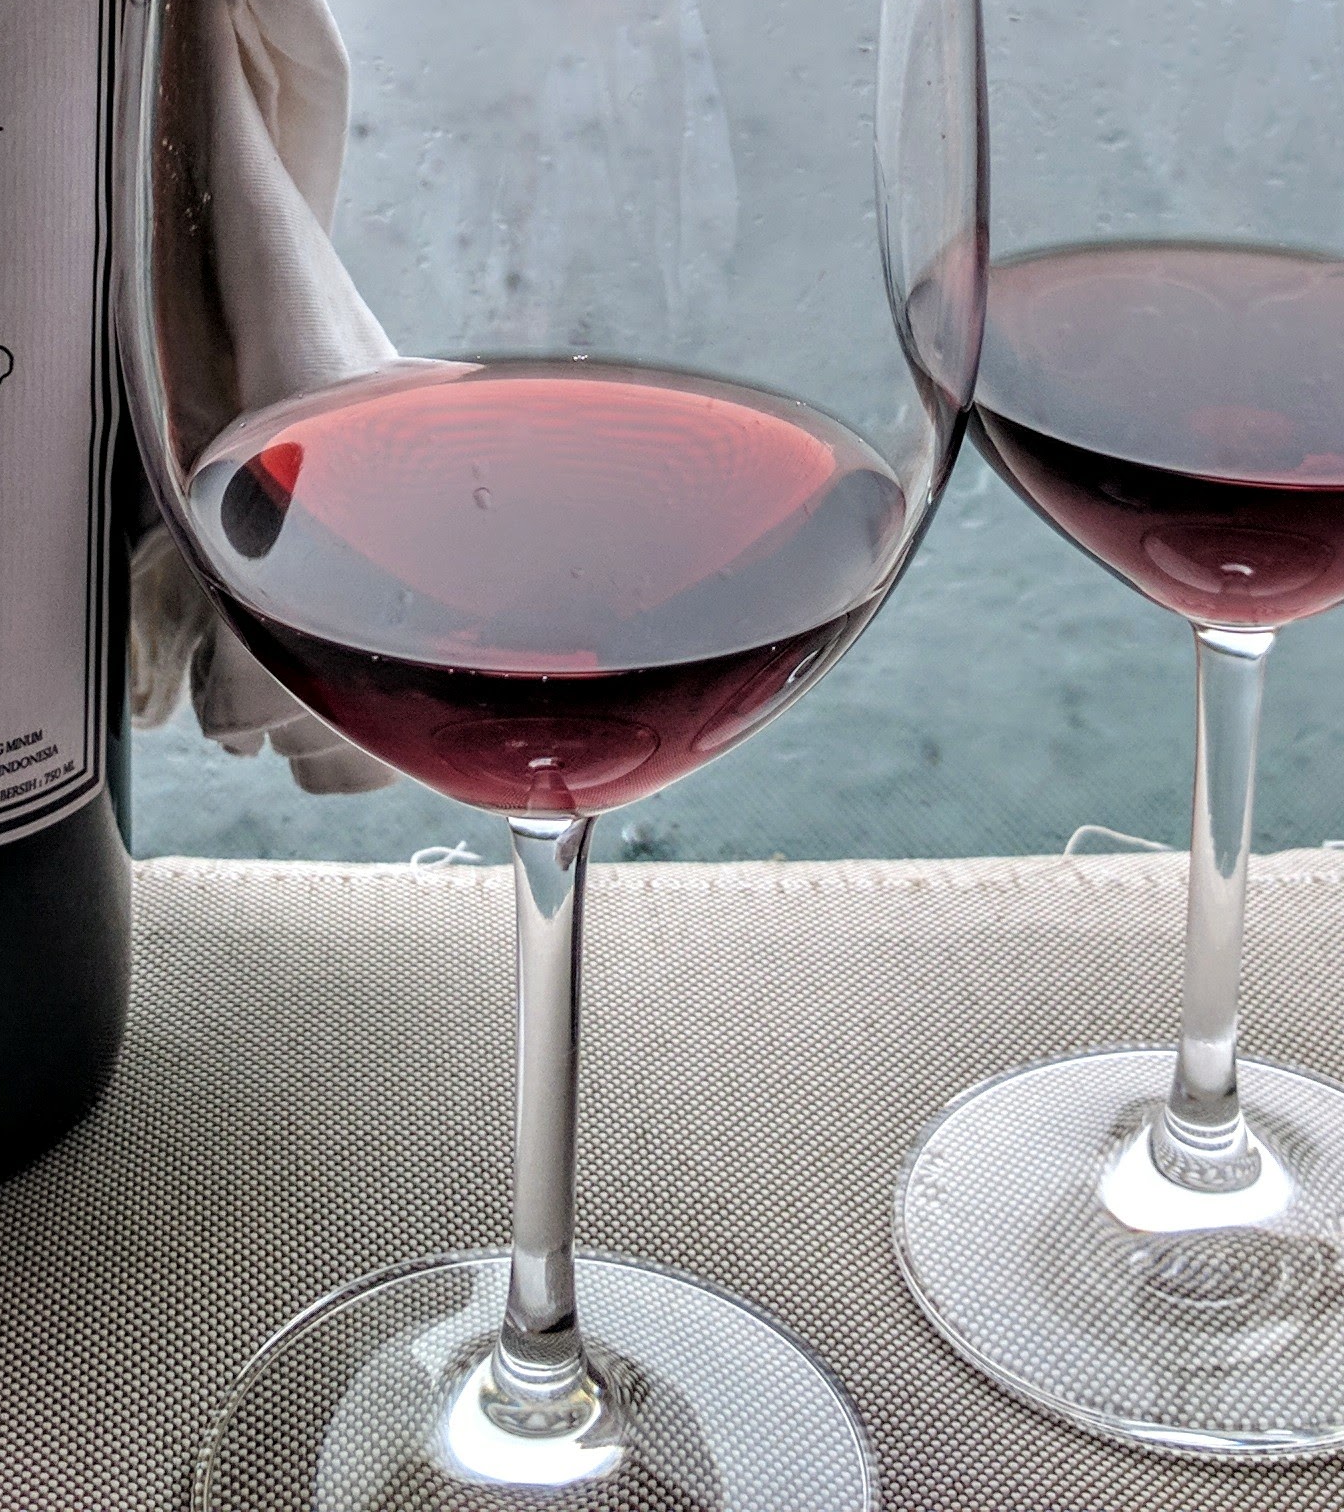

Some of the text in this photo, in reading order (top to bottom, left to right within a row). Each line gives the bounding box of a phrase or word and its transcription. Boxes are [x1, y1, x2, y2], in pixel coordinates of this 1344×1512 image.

[6, 729, 43, 754] MINUM
[0, 777, 38, 803] BERSIH
[44, 767, 62, 785] 750
